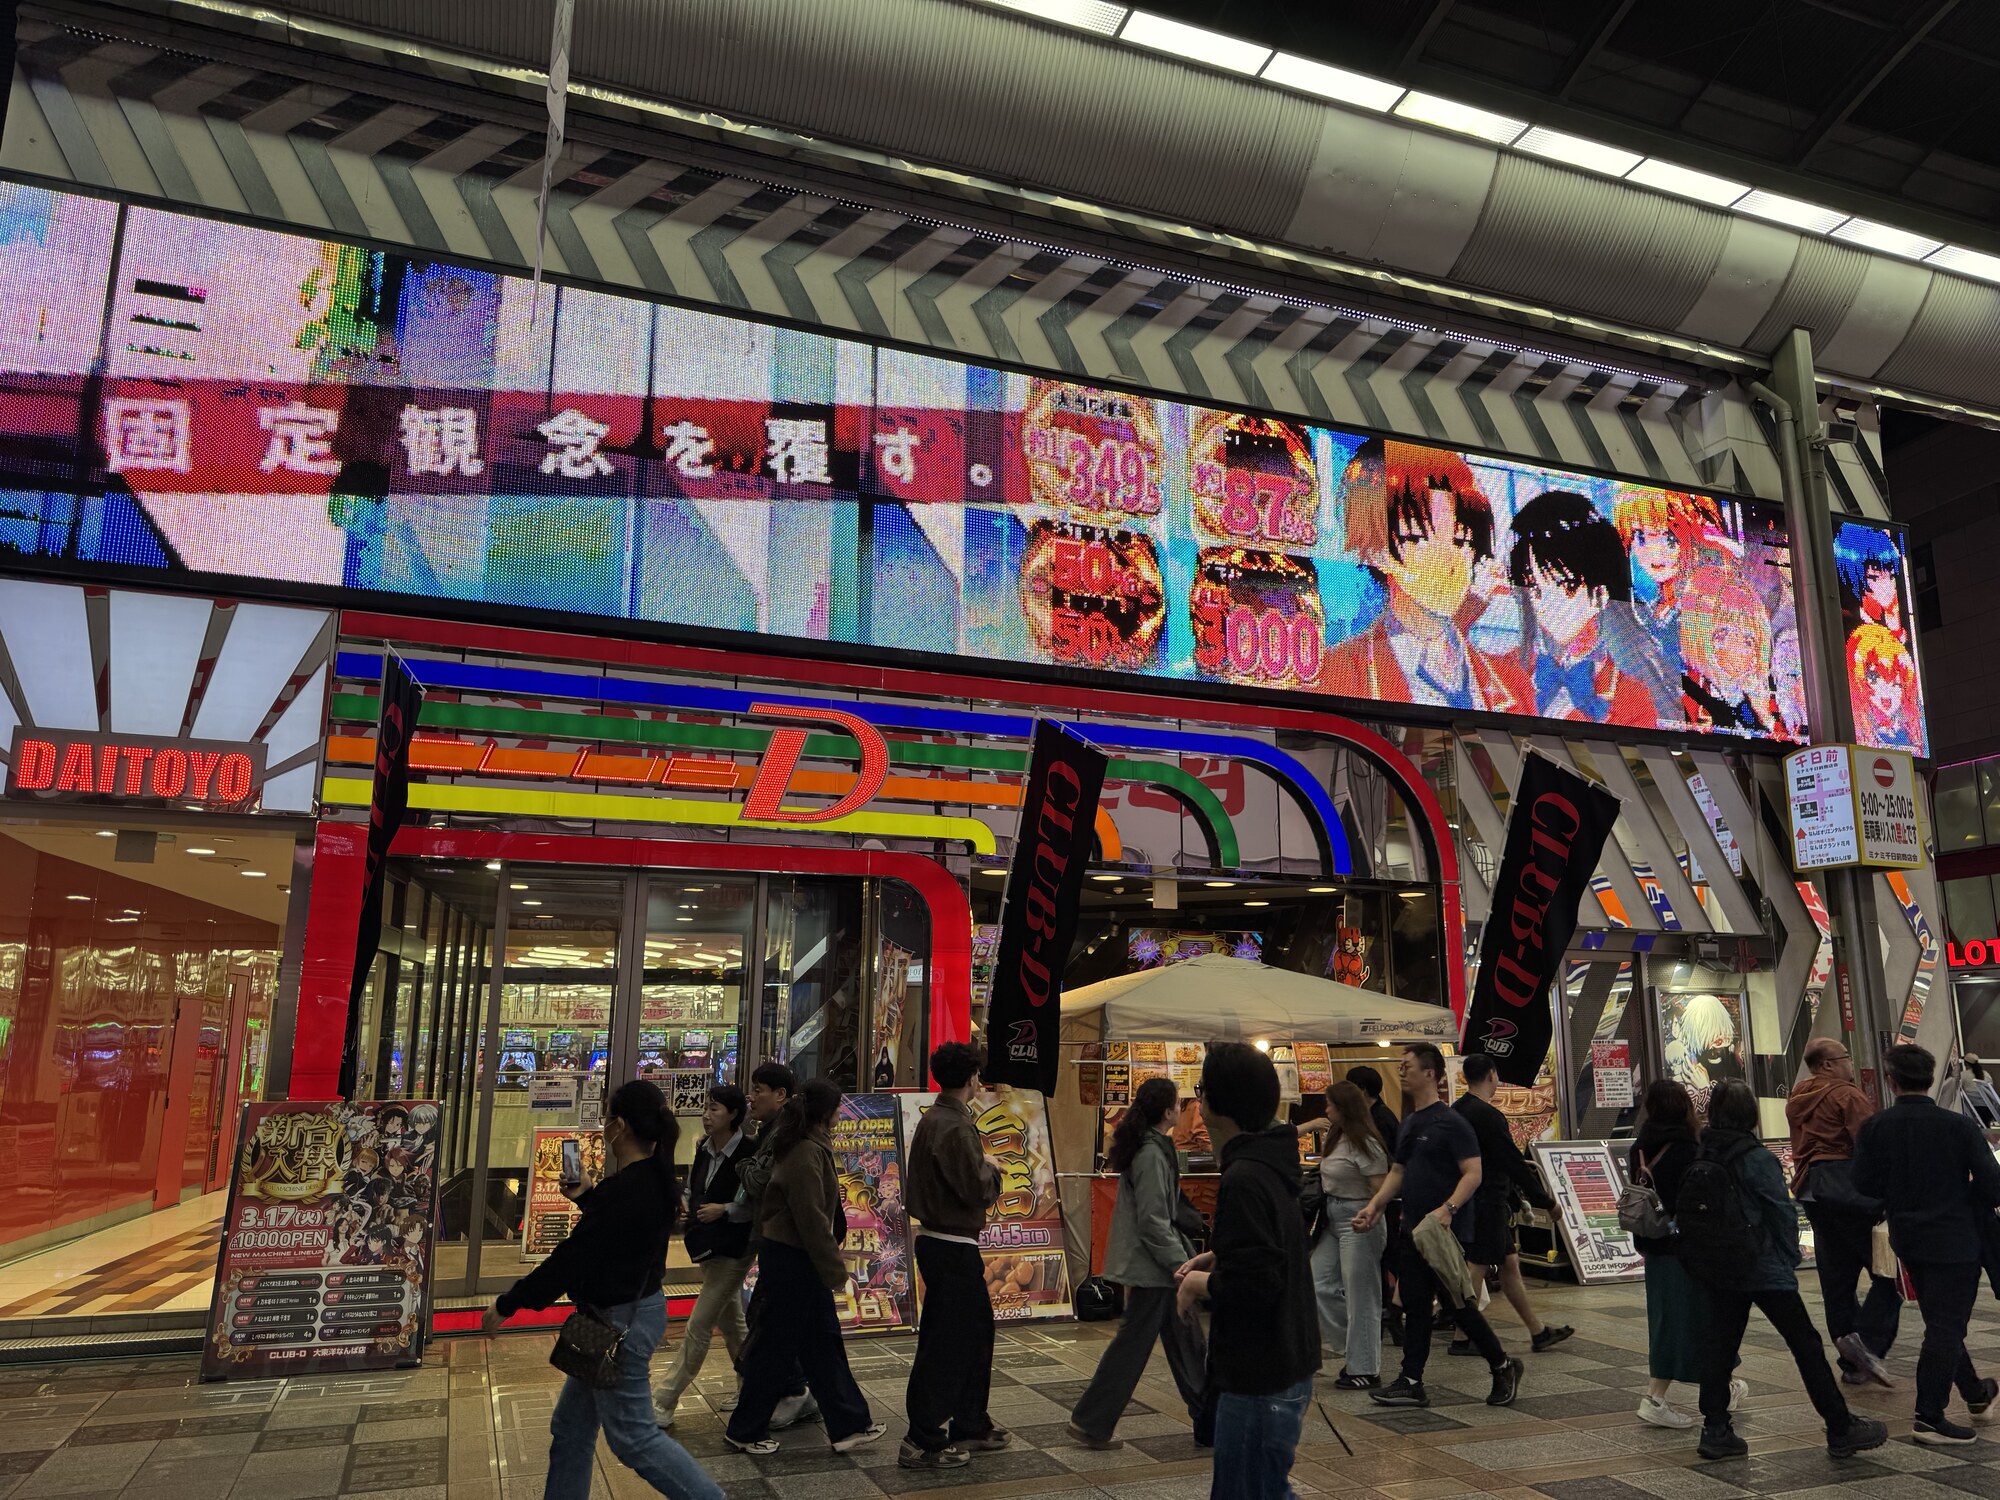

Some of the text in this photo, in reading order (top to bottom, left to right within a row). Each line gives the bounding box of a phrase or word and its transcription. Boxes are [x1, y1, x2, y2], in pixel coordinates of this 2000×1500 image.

[103, 396, 994, 488] 固定観念を覆す。
[16, 739, 255, 801] DAITOYO
[1795, 749, 1838, 768] 千日前
[1020, 760, 1081, 1007] CLUB-D
[1494, 792, 1581, 1008] CLUB-D
[675, 1074, 705, 1090] 絶対
[261, 1113, 338, 1148] 新台
[859, 1118, 894, 1133] OPEN
[868, 1136, 897, 1150] TIME
[257, 1147, 336, 1182] 入替
[240, 1205, 324, 1228] 3.17(火)
